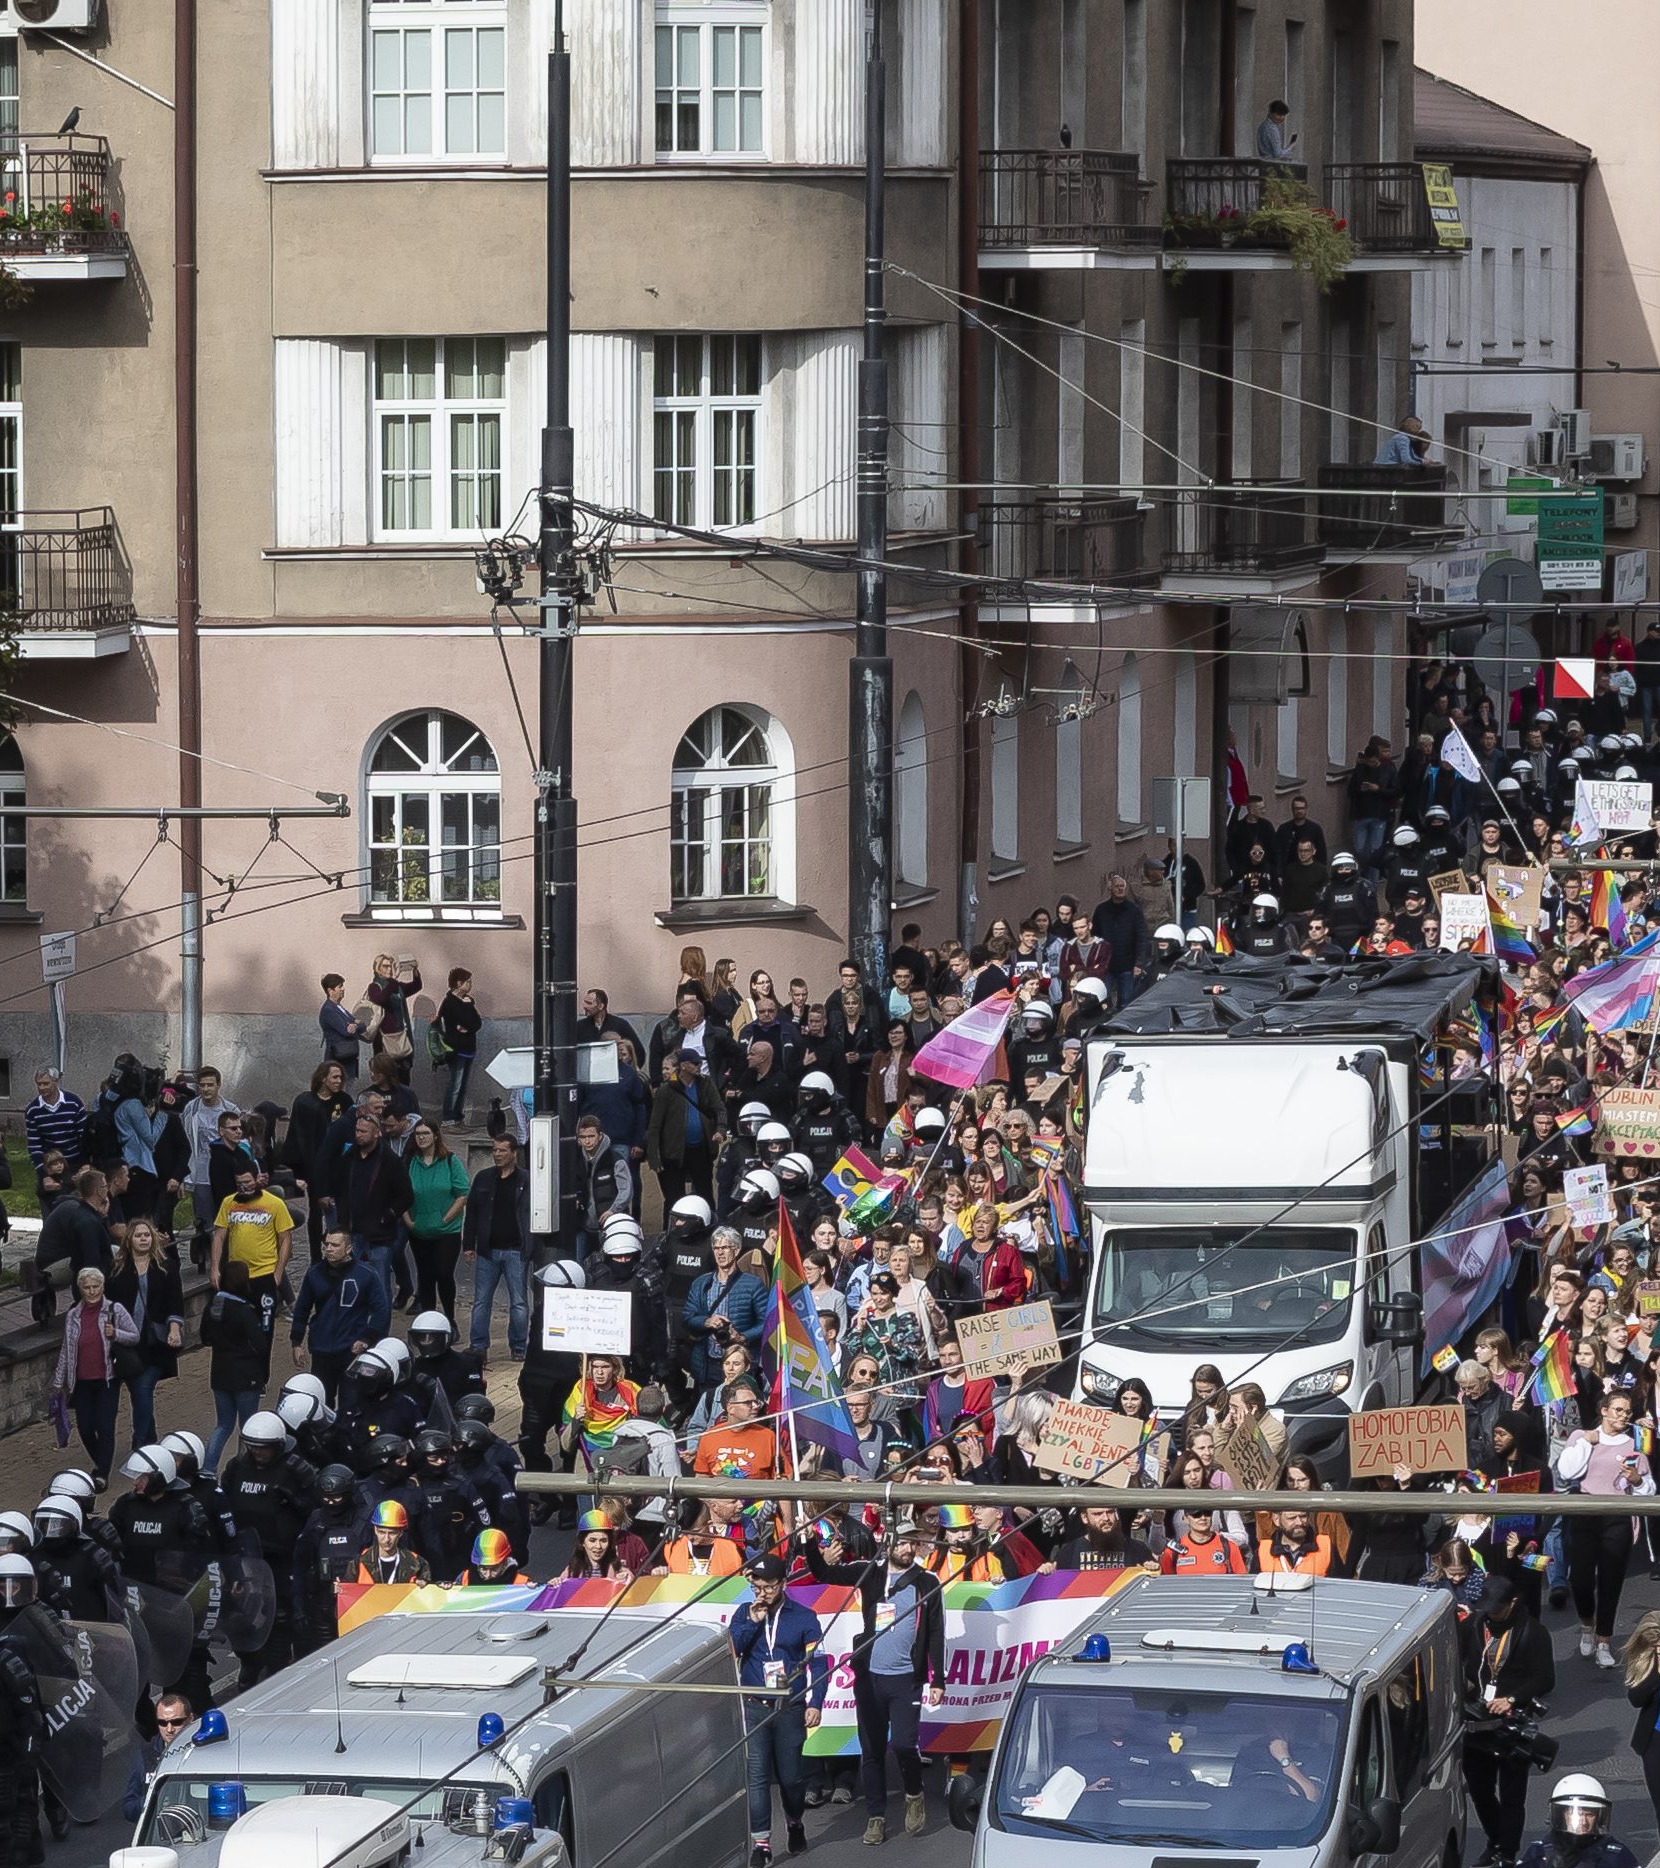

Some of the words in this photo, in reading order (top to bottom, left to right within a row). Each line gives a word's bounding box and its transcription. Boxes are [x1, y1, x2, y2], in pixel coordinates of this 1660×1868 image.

[1542, 508, 1600, 518] TELEFONY
[1541, 548, 1601, 558] AKCESORIA
[1618, 785, 1639, 799] GET
[1027, 1053, 1049, 1064] POLICJA
[1603, 1089, 1655, 1106] LUBLIN
[1602, 1108, 1657, 1123] MIASTEM
[810, 1126, 833, 1137] POLICJA
[1588, 1183, 1605, 1193] NOT
[744, 1227, 767, 1240] POLICJA
[677, 1254, 702, 1267] POLICJA
[959, 1313, 1002, 1342] RAISE
[1006, 1304, 1049, 1329] GIRLS
[968, 1358, 993, 1379] THE
[998, 1349, 1028, 1368] SAME
[1032, 1343, 1058, 1362] WAY
[1056, 1401, 1112, 1429] TWARDE,
[1352, 1406, 1464, 1443] HOMOFOBIA
[1069, 1438, 1087, 1456] AL
[1356, 1438, 1456, 1470] ZABIJA
[133, 1520, 163, 1535] POLICJA
[324, 1535, 352, 1546] POLICJA
[200, 1561, 221, 1643] POLICJA
[971, 1693, 1001, 1705] PRZED
